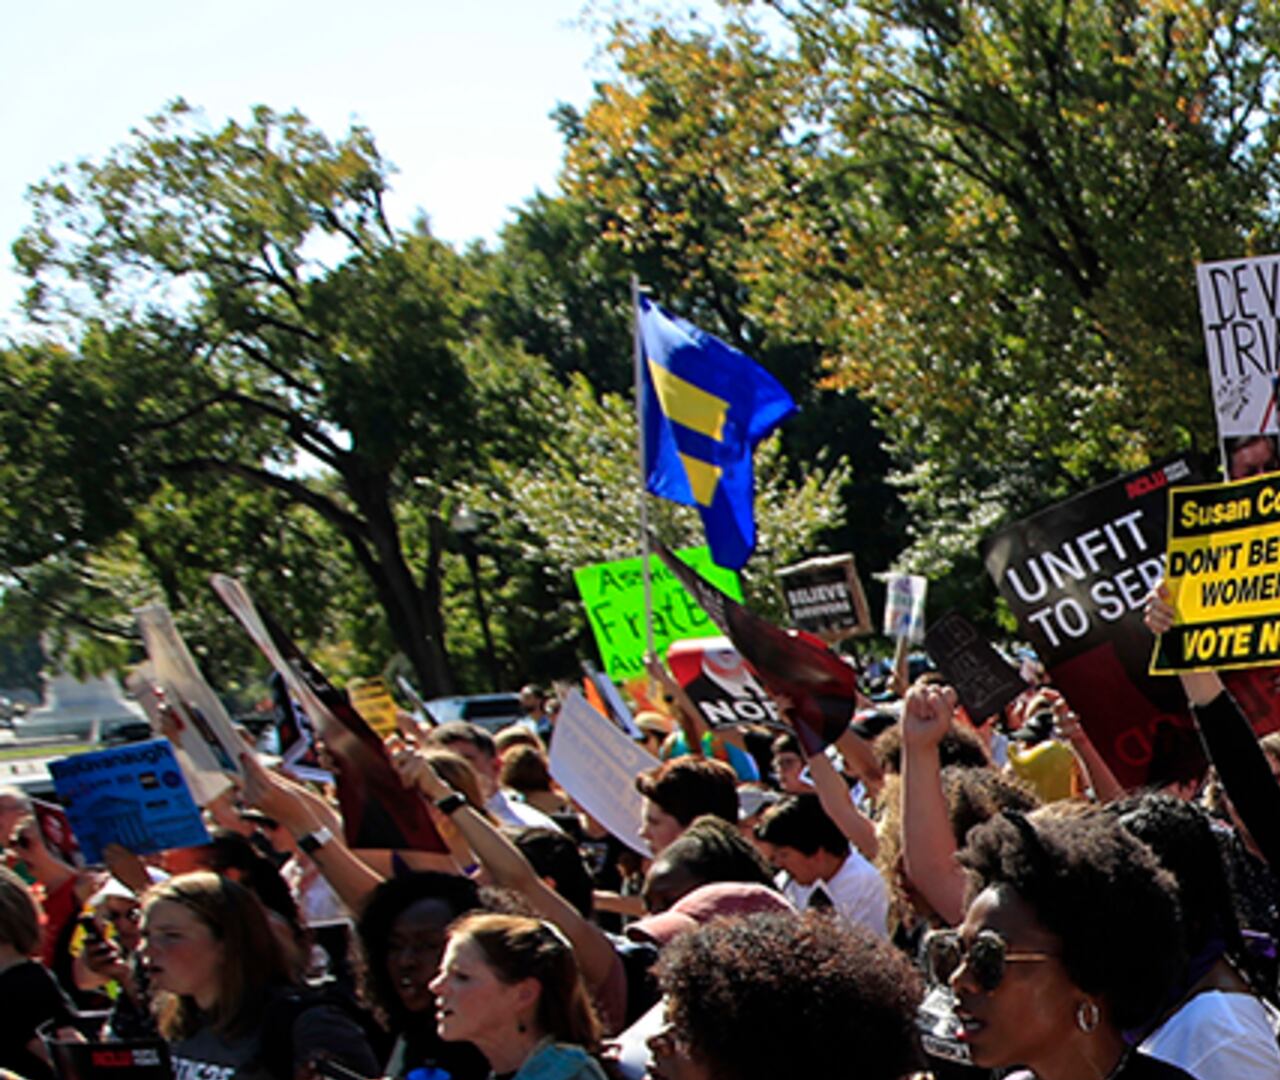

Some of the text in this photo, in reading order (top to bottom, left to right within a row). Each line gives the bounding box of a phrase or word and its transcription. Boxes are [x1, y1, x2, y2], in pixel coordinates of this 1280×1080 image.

[1181, 499, 1251, 528] Susan
[1007, 510, 1148, 602] UNFIT
[1169, 542, 1243, 577] DON'T
[1029, 554, 1167, 648] TO SER
[1184, 623, 1253, 661] VOTE
